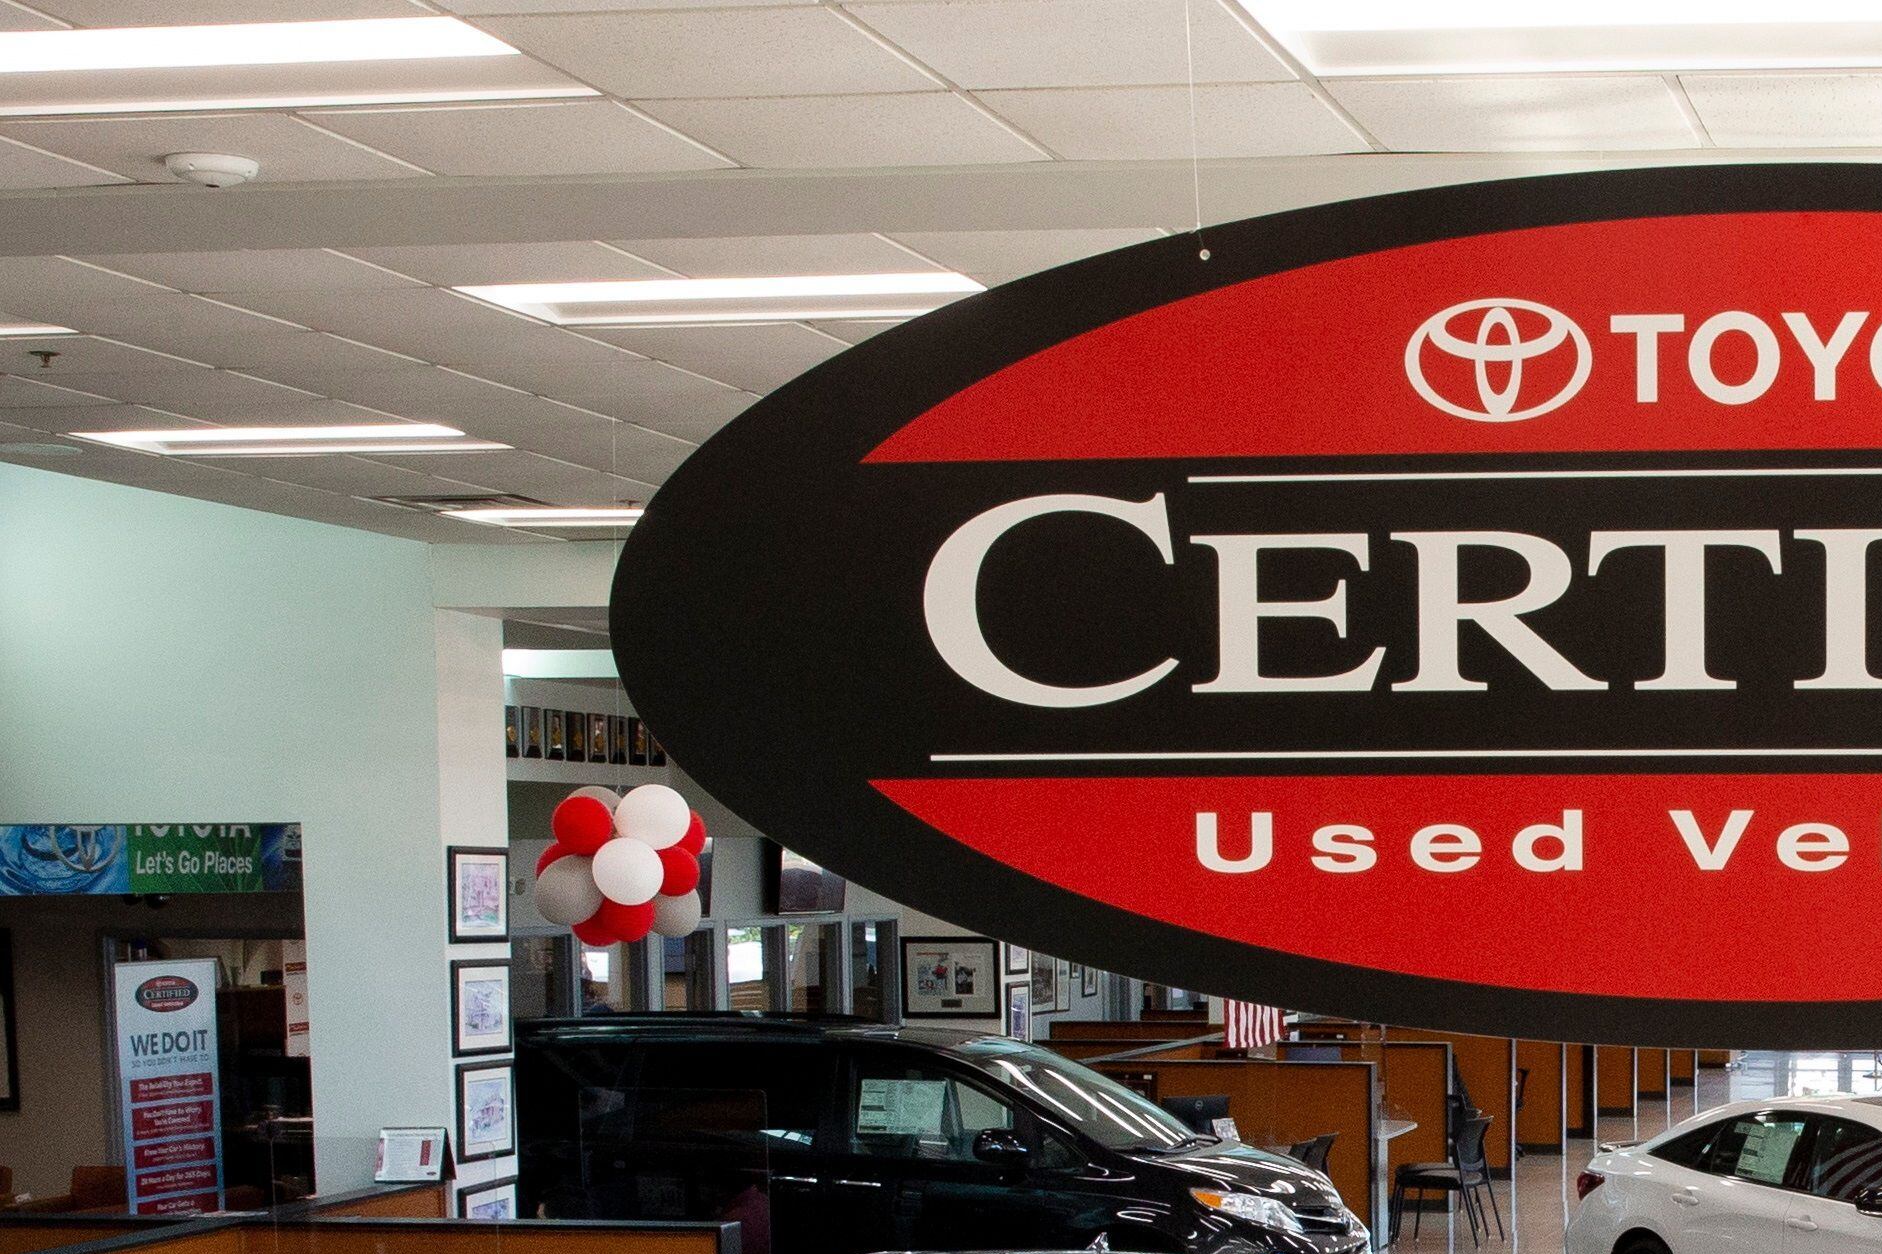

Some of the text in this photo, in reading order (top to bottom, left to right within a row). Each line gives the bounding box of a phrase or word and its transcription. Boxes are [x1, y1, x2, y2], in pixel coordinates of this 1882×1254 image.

[1197, 810, 1582, 872] Used
[136, 850, 253, 875] Let's Go Places
[130, 1029, 208, 1057] WE DO IT
